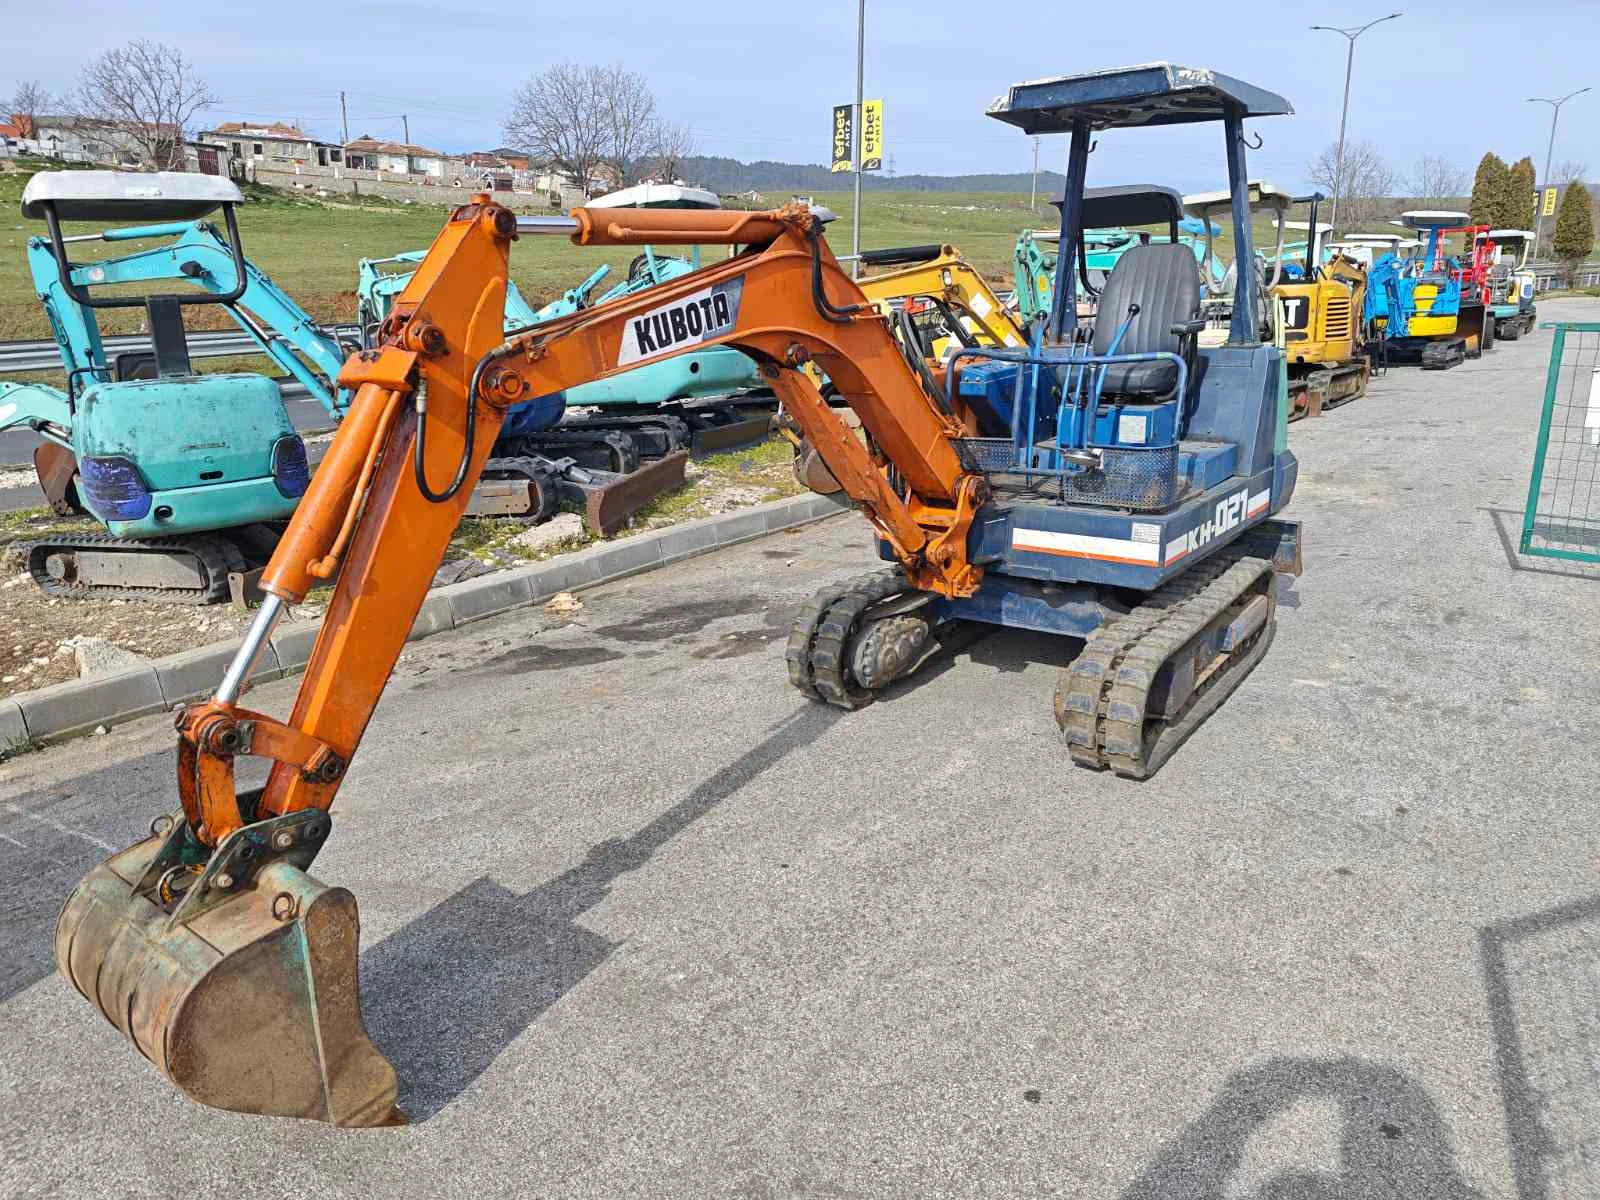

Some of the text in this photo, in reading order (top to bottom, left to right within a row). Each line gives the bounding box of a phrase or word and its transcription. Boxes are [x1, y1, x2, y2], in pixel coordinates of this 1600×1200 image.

[835, 109, 845, 159] efbet
[865, 105, 874, 153] efbet
[633, 292, 730, 355] KUBOTA
[1187, 487, 1249, 553] KH-021
